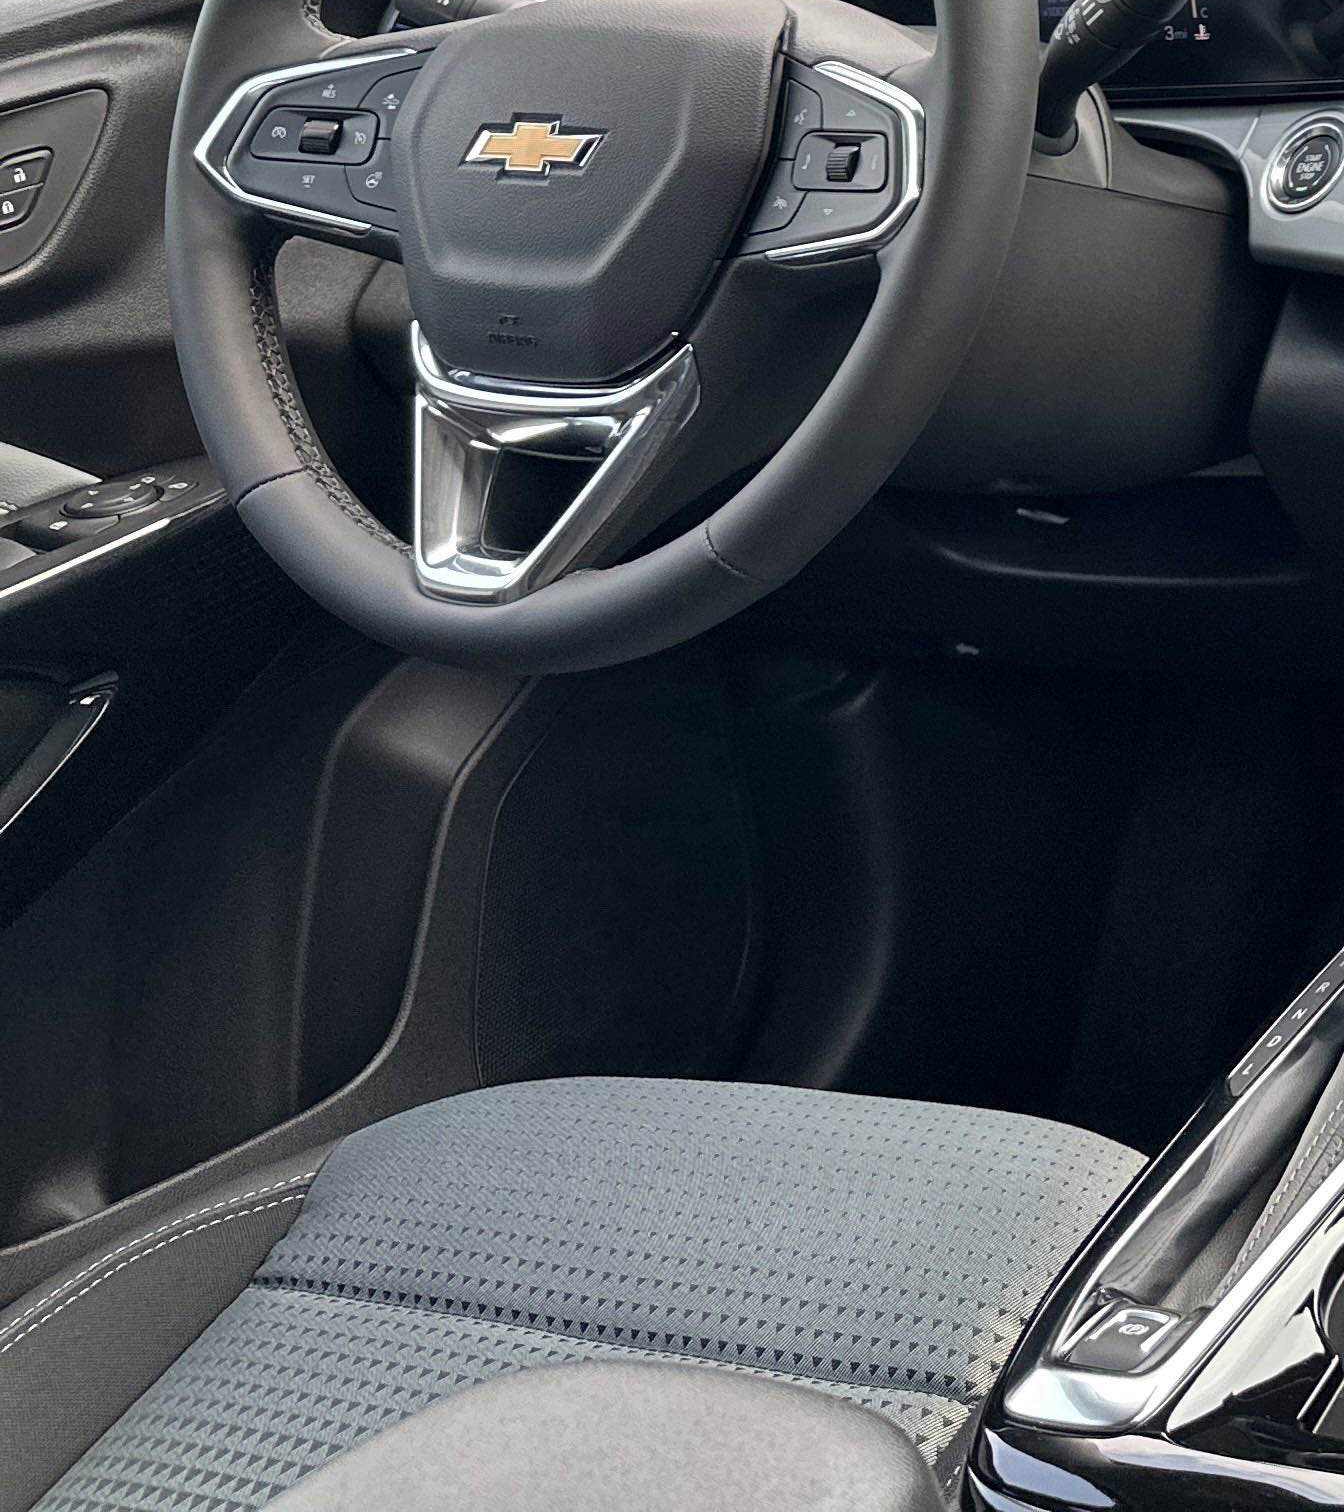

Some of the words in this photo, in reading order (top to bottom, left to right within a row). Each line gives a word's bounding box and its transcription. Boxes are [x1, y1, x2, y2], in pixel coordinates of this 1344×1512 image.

[302, 175, 315, 184] SET
[1315, 982, 1330, 994] R
[1291, 1008, 1308, 1020] N
[1266, 1036, 1282, 1048] D
[1242, 1063, 1254, 1075] L
